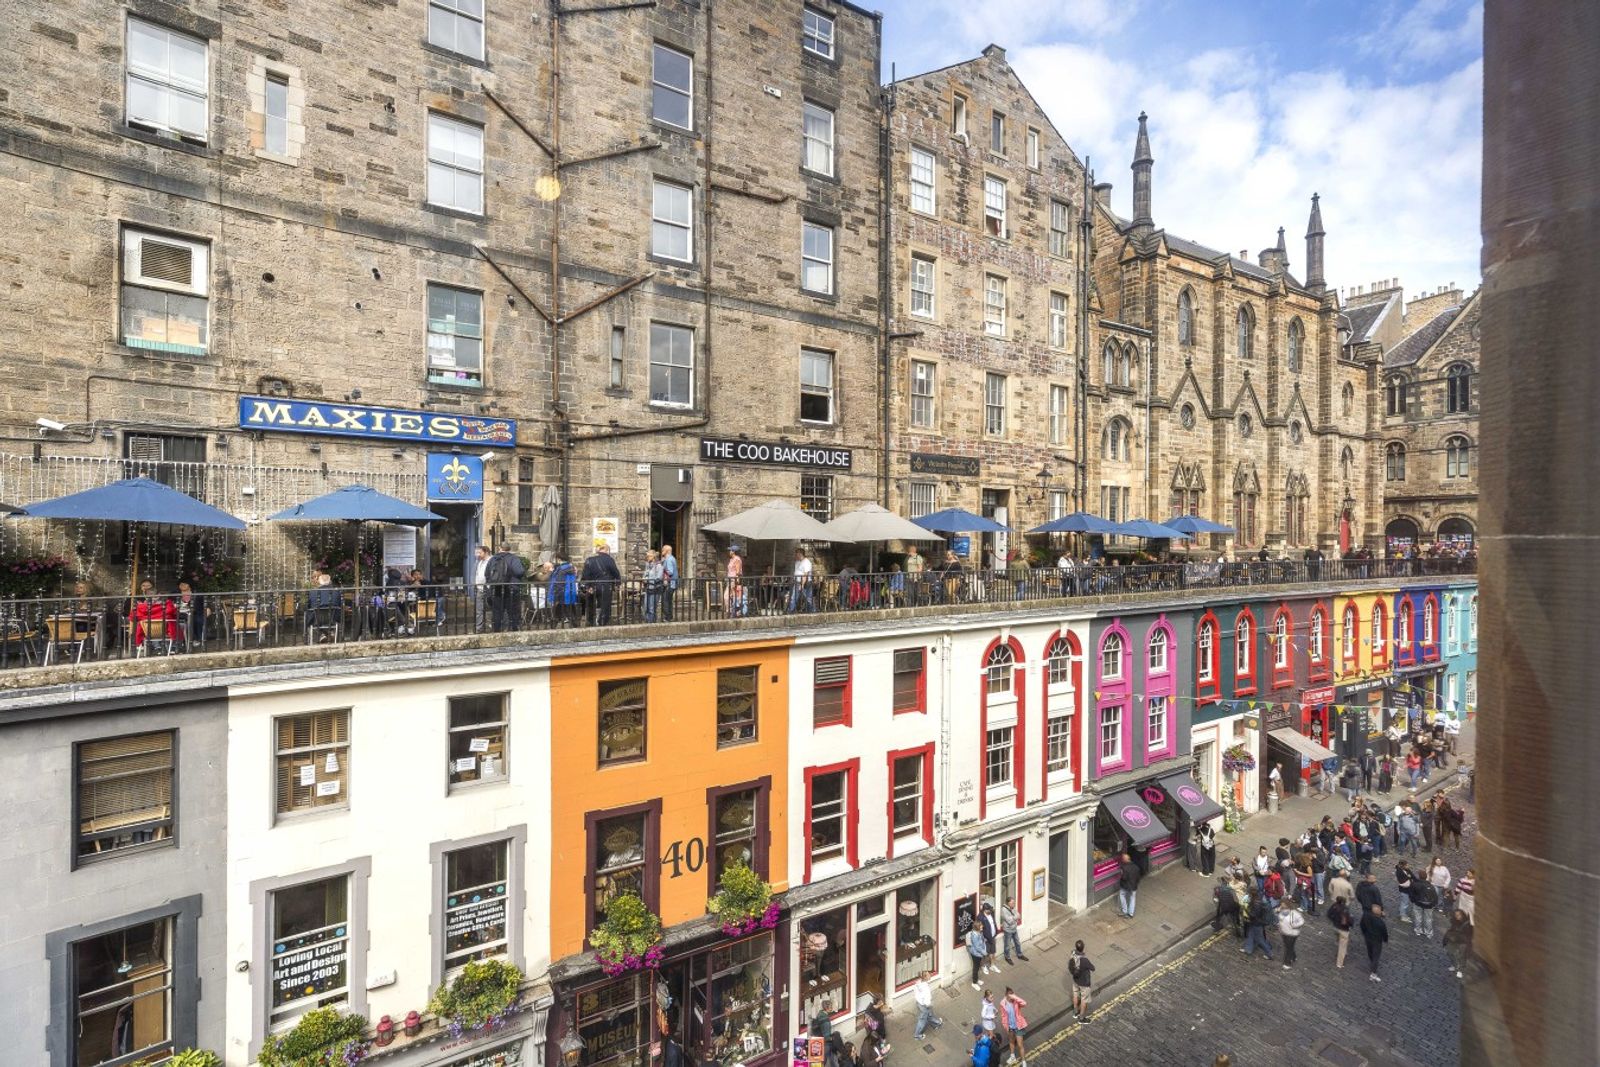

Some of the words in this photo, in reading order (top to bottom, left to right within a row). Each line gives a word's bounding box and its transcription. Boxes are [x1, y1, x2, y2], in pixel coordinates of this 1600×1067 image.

[248, 401, 461, 438] MAXIES
[703, 440, 734, 458] THE
[737, 443, 770, 461] COO
[773, 446, 850, 466] BAKEHOUSE
[660, 837, 704, 879] 40
[273, 967, 290, 980] Art
[290, 961, 311, 976] and
[311, 952, 348, 970] Design
[278, 950, 313, 968] Loving
[314, 942, 343, 957] Local
[280, 974, 311, 990] Since
[312, 964, 339, 981] 2003
